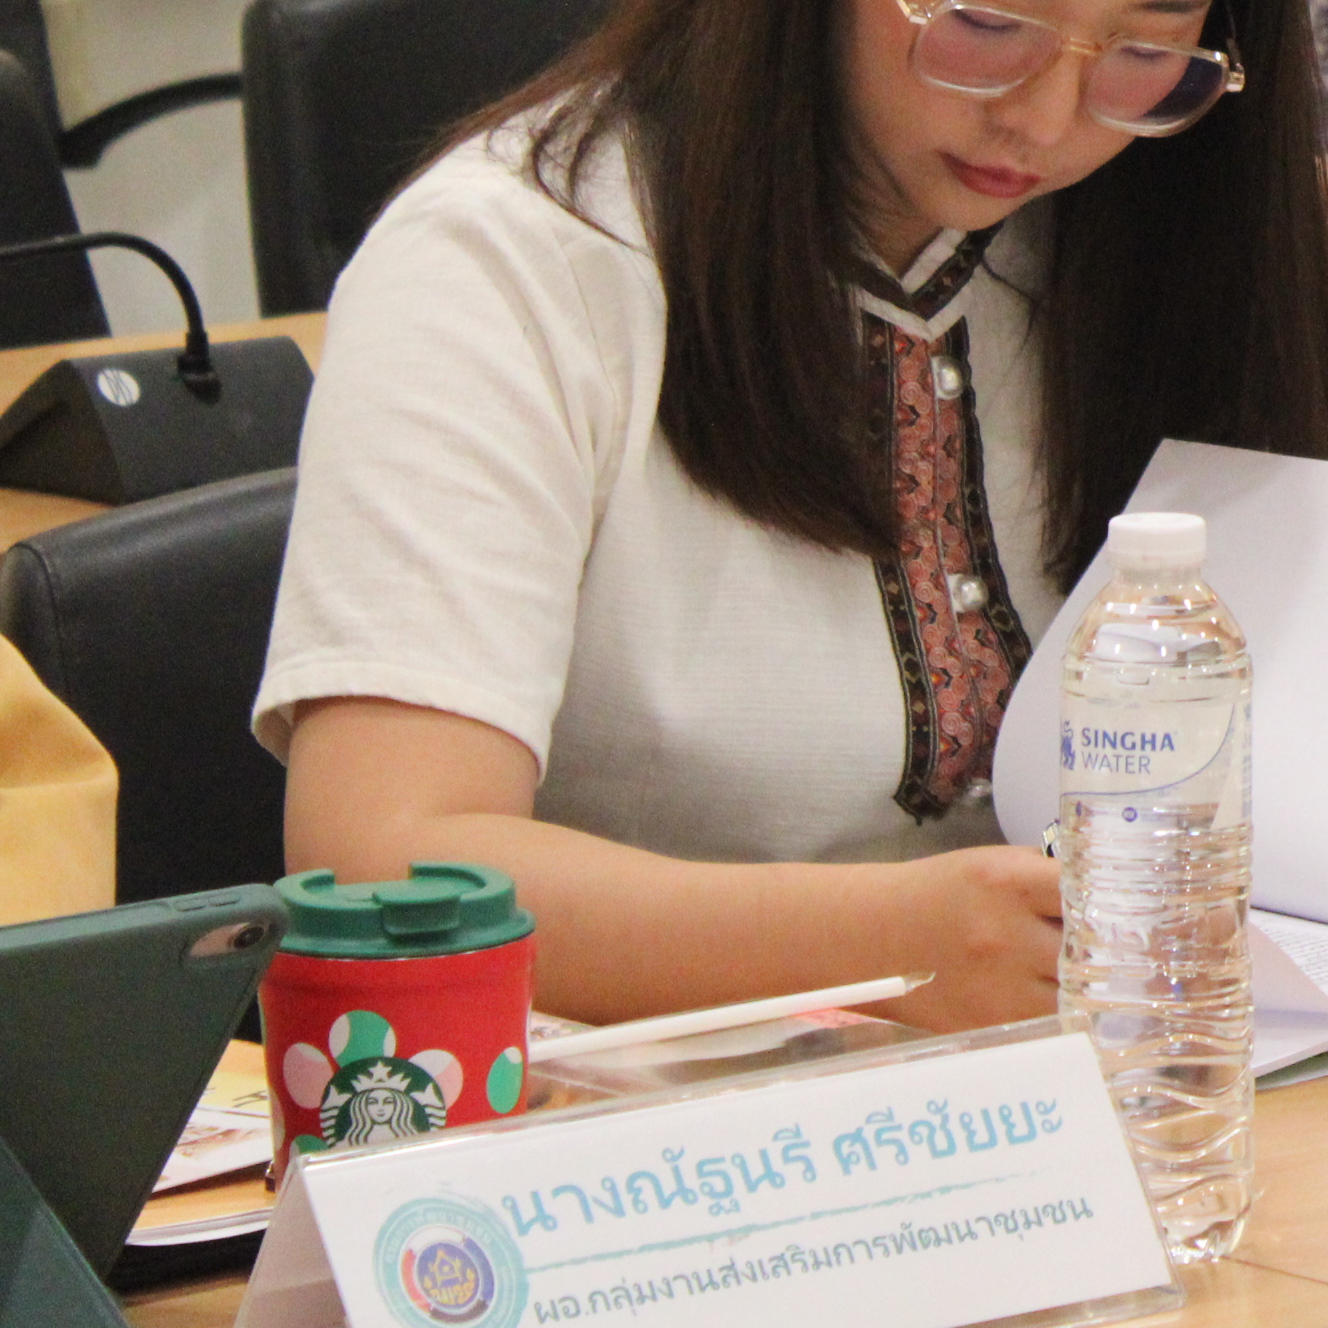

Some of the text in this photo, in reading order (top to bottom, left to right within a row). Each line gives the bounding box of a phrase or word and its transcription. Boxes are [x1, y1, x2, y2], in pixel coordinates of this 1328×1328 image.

[1081, 727, 1176, 752] SINGHA
[1081, 751, 1151, 775] WATER
[501, 1099, 1064, 1238] นางณัฐนรี ศรีชัยยะ
[534, 1194, 1094, 1324] ผอ.กลุ่มงานส่งเสริมการพัฒนาชุมชน
